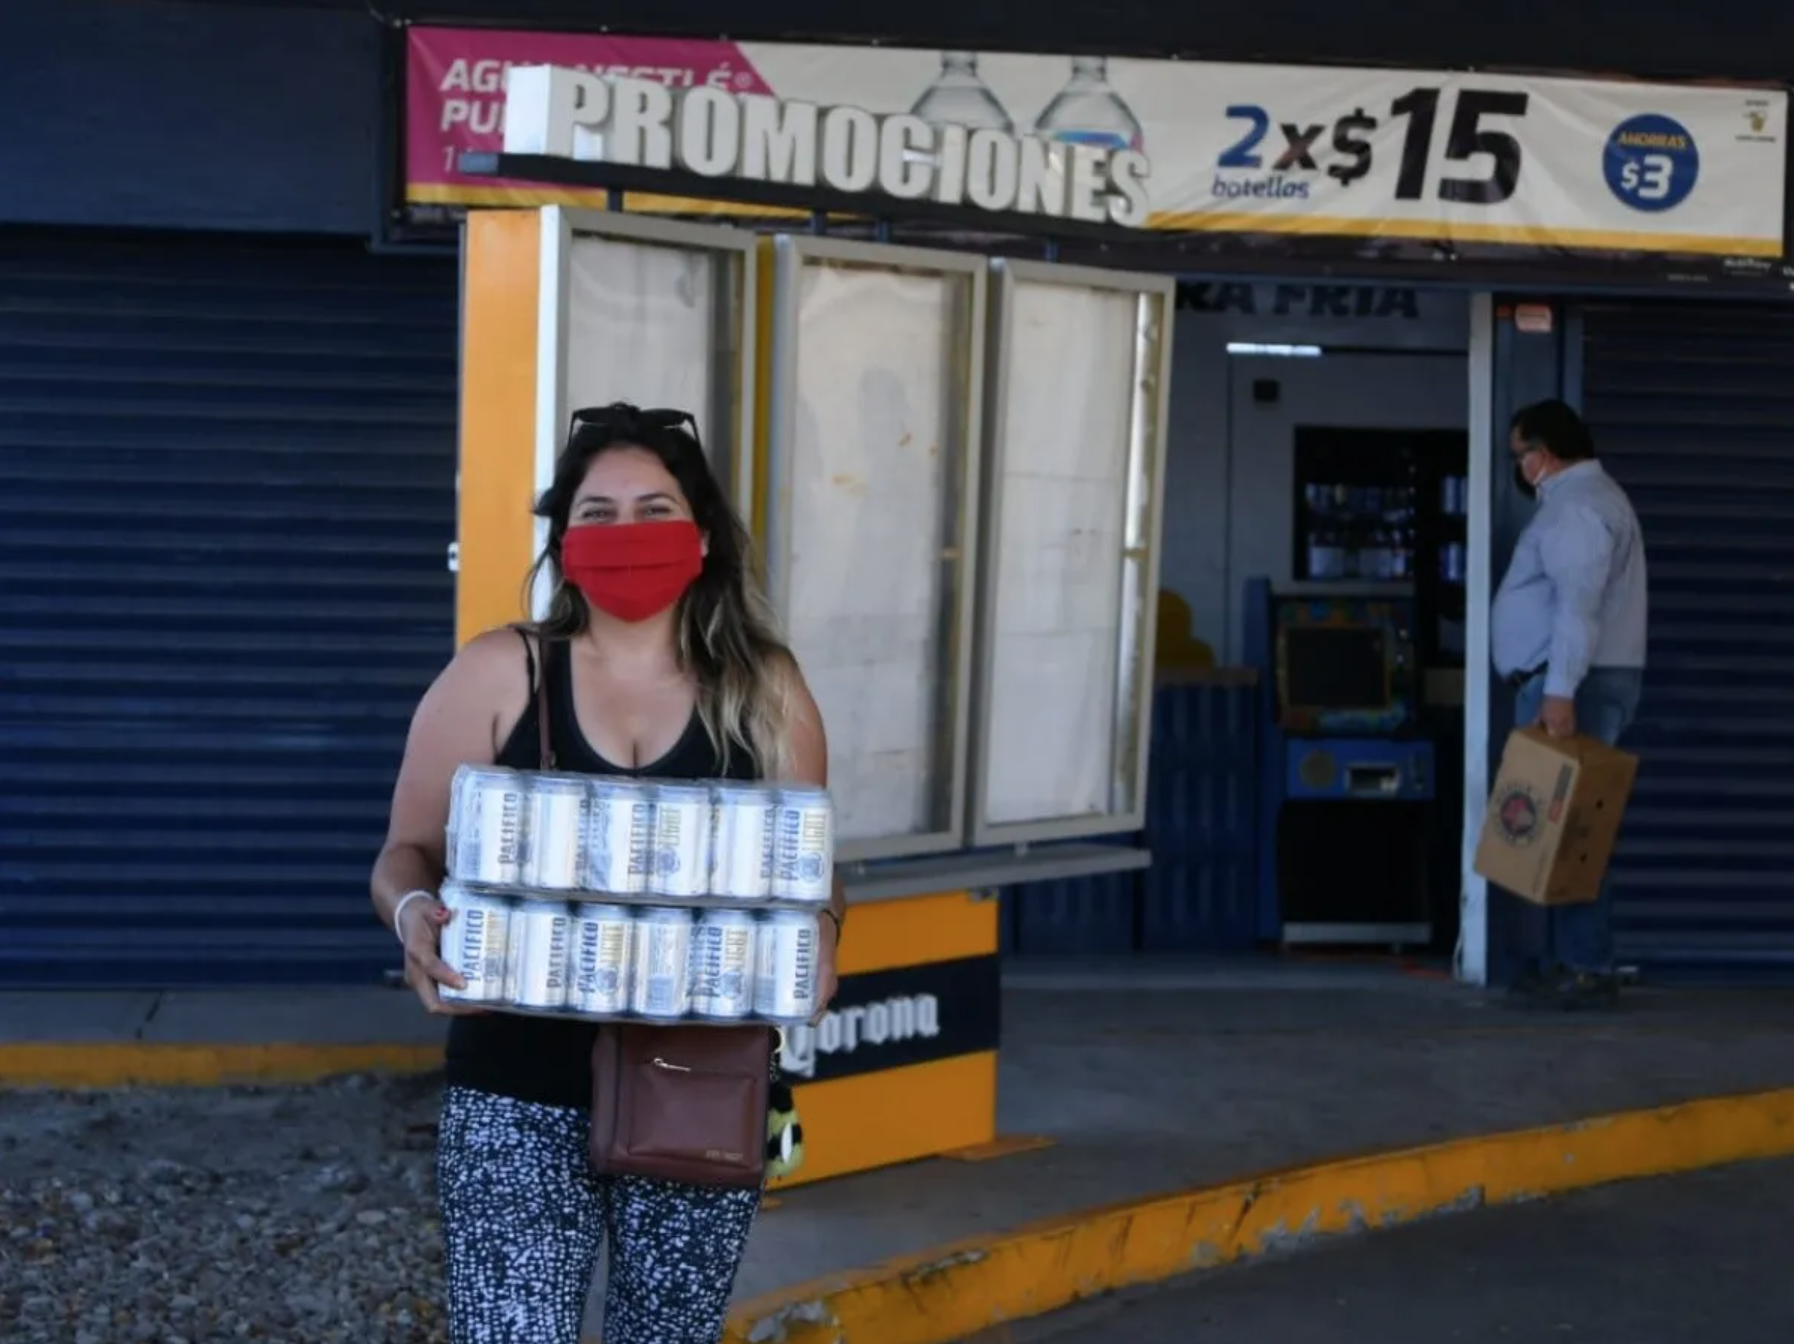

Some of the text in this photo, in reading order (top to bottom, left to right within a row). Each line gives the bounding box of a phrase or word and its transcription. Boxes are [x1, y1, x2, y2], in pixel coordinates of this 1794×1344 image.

[547, 64, 1150, 228] PROMOCIONES
[1621, 154, 1673, 199] $3
[1211, 174, 1310, 199] botellas
[498, 792, 518, 865] PACIFICO
[628, 803, 646, 875] PACIFICO
[780, 809, 800, 881] PACIFICO
[463, 909, 485, 982] PACIFICO
[547, 917, 567, 988] PACIFICO
[577, 921, 599, 993] PACIFICO
[703, 927, 723, 998] PACIFICO
[793, 928, 811, 1000] PACIFICO
